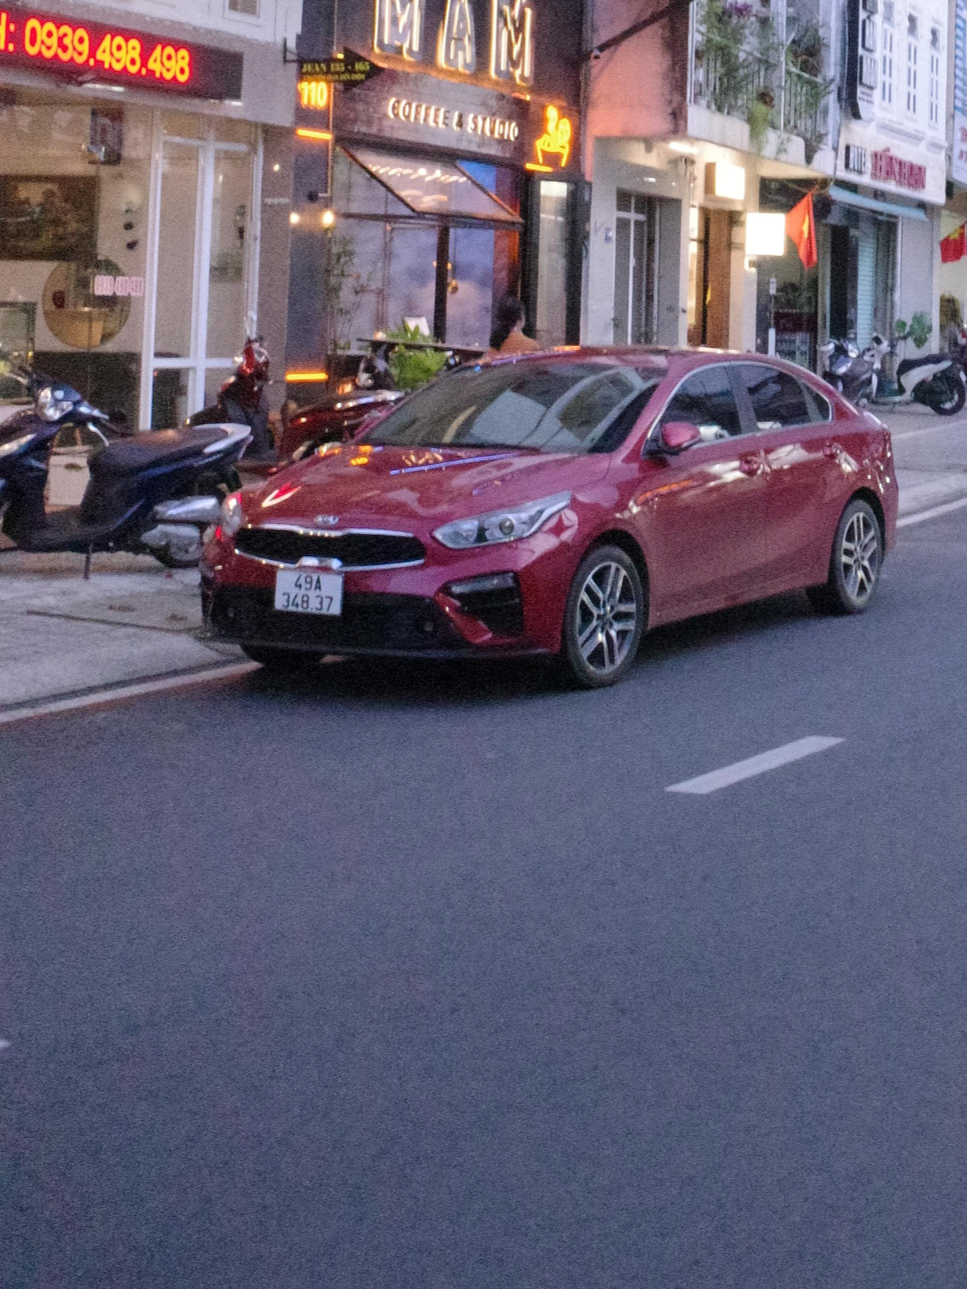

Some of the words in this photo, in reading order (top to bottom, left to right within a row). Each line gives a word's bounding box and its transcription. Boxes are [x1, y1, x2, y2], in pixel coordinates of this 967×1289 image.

[24, 17, 191, 83] 0939.498.498
[297, 81, 328, 108] 110
[387, 97, 450, 128] COFFEE
[452, 110, 463, 131] &
[467, 113, 519, 141] STUDIO
[294, 575, 322, 591] 49A
[282, 592, 333, 612] 348.37
